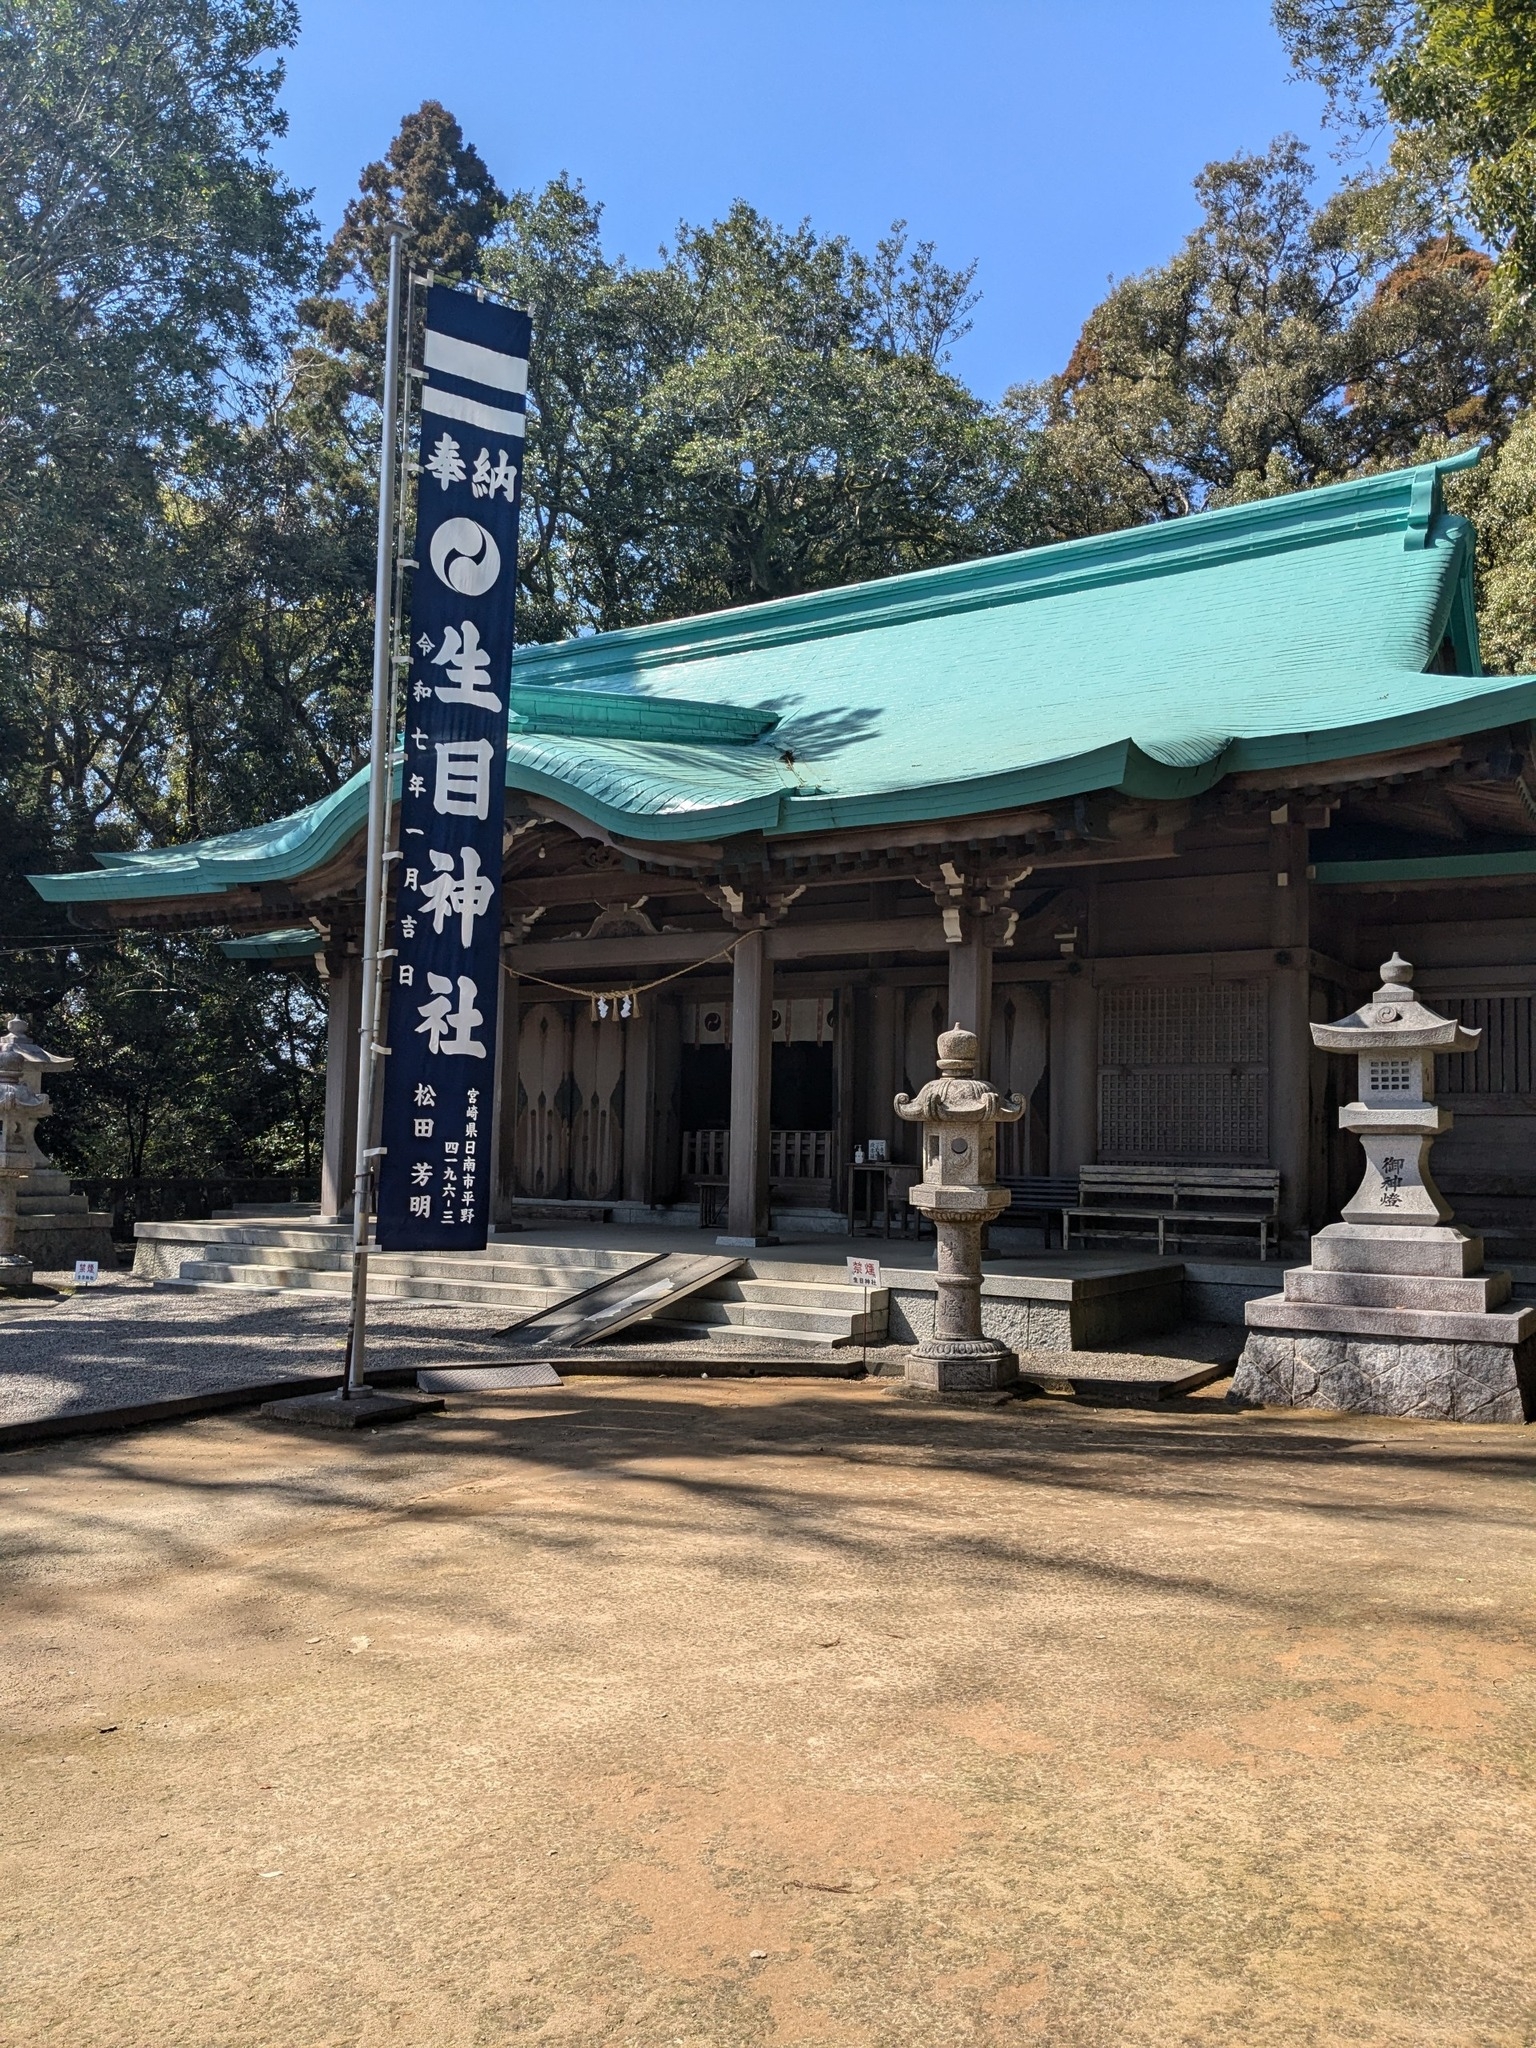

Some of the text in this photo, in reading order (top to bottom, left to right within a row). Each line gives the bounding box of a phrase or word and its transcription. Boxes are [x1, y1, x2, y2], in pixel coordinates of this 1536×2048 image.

[424, 432, 518, 503] 奉納
[398, 632, 435, 987] 令和七年一月吉日
[414, 620, 502, 1059] 生目神社
[409, 1082, 437, 1219] 松田芳明
[459, 1087, 480, 1225] 宮崎県日南市平野
[1380, 1156, 1405, 1208] 御神燈
[852, 1261, 876, 1277] 禁煙
